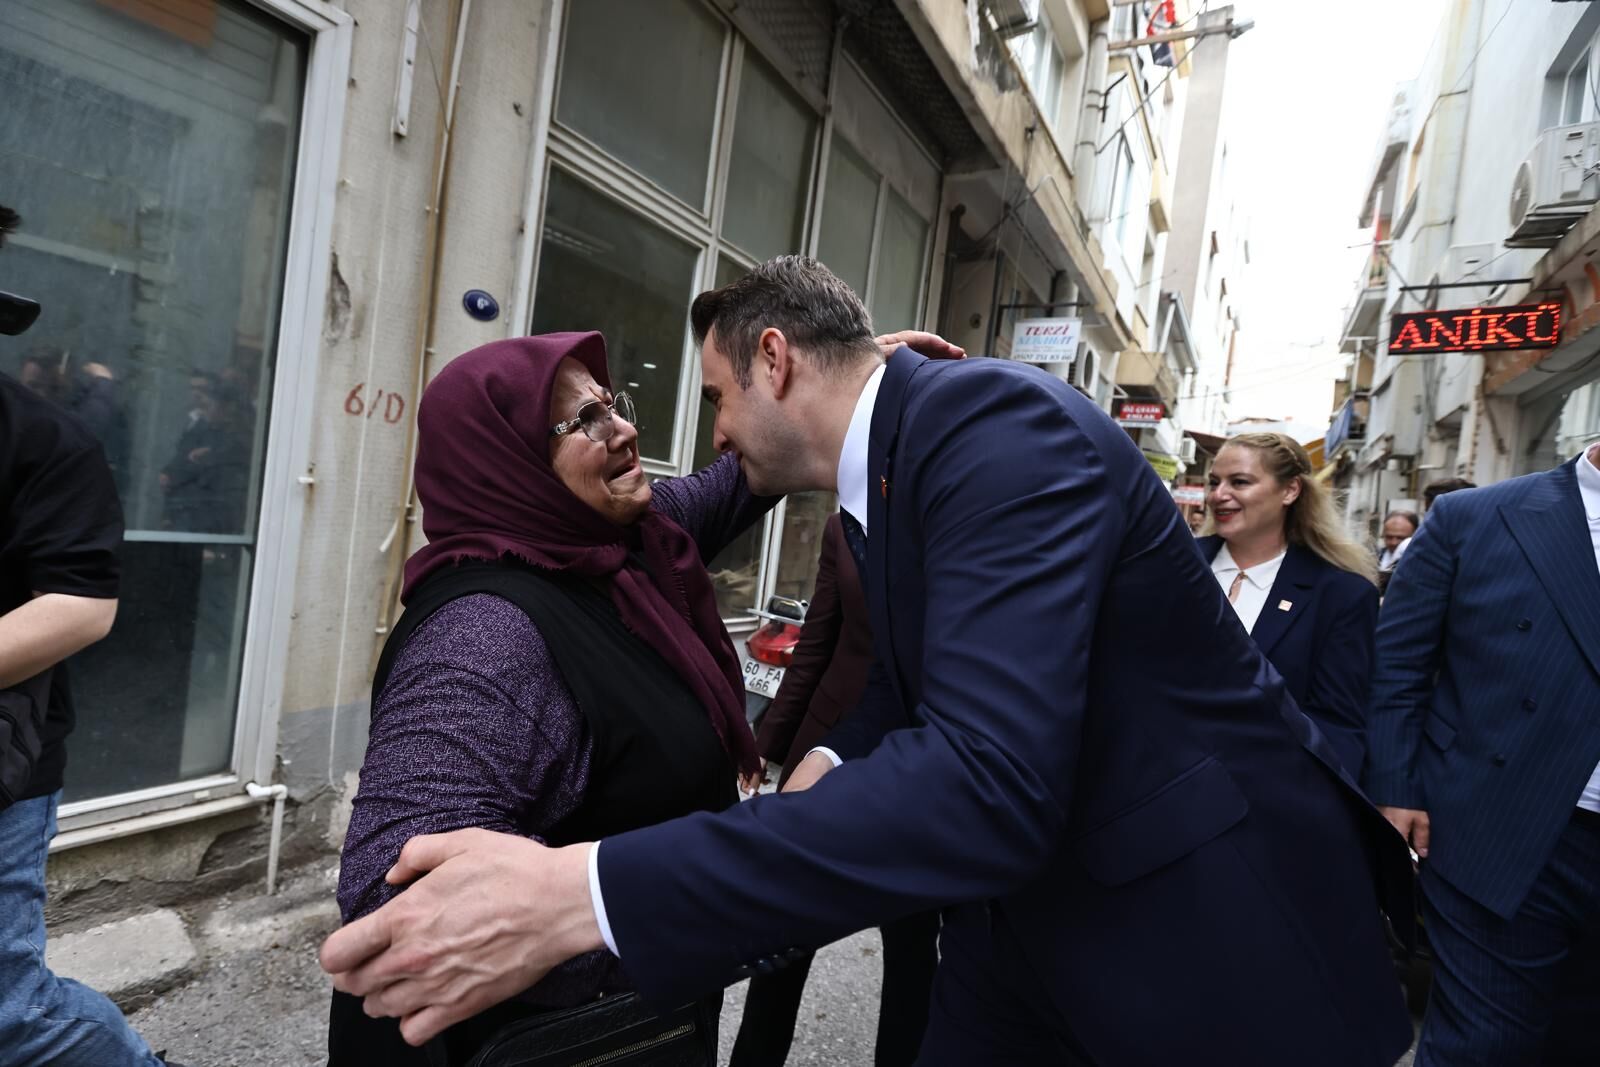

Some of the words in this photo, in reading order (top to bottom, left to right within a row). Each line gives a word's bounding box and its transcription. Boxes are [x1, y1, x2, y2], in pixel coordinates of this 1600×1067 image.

[1025, 324, 1070, 336] TERZİ
[344, 383, 405, 424] 6/D
[745, 662, 759, 675] 60
[765, 668, 781, 682] FA
